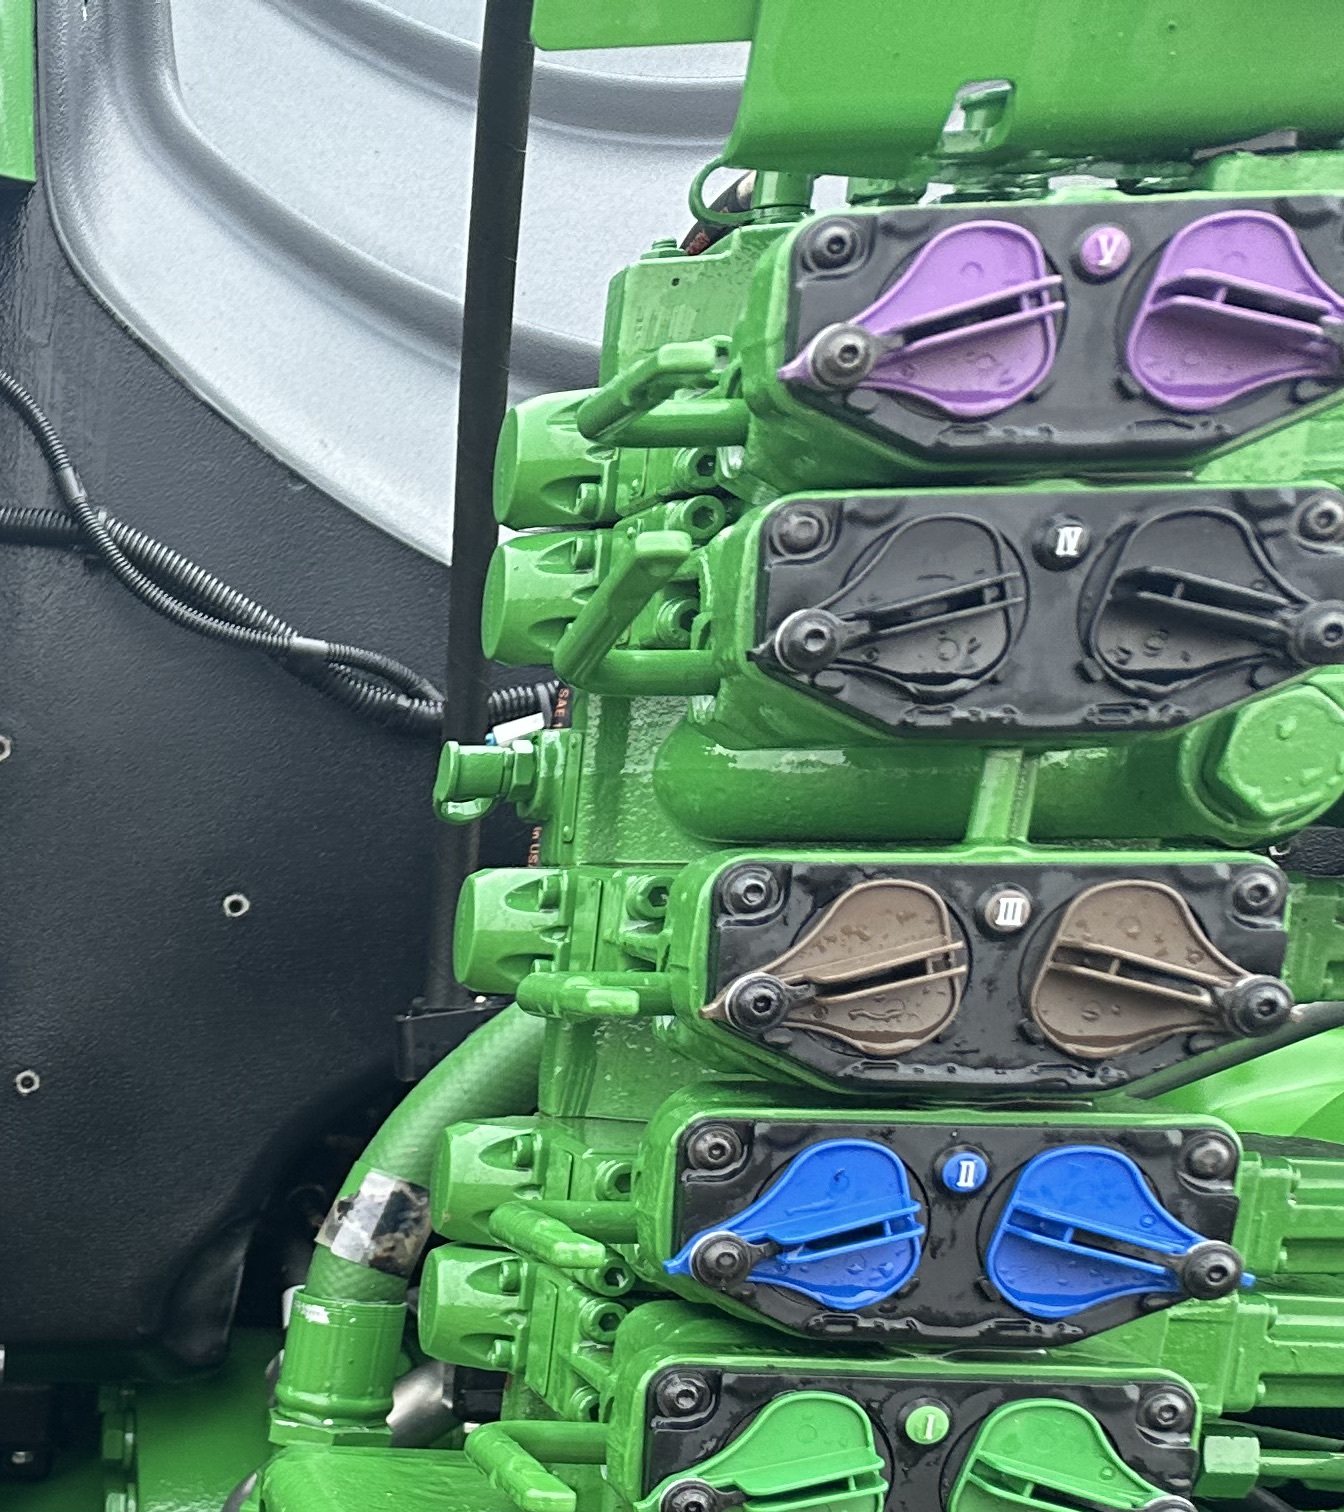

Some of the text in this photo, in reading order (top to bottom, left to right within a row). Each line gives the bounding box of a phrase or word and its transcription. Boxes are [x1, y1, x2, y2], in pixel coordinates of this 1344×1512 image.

[1096, 233, 1123, 266] V
[1055, 526, 1083, 556] IV
[554, 687, 570, 717] SAE
[995, 897, 1025, 926] III
[956, 1160, 978, 1187] II
